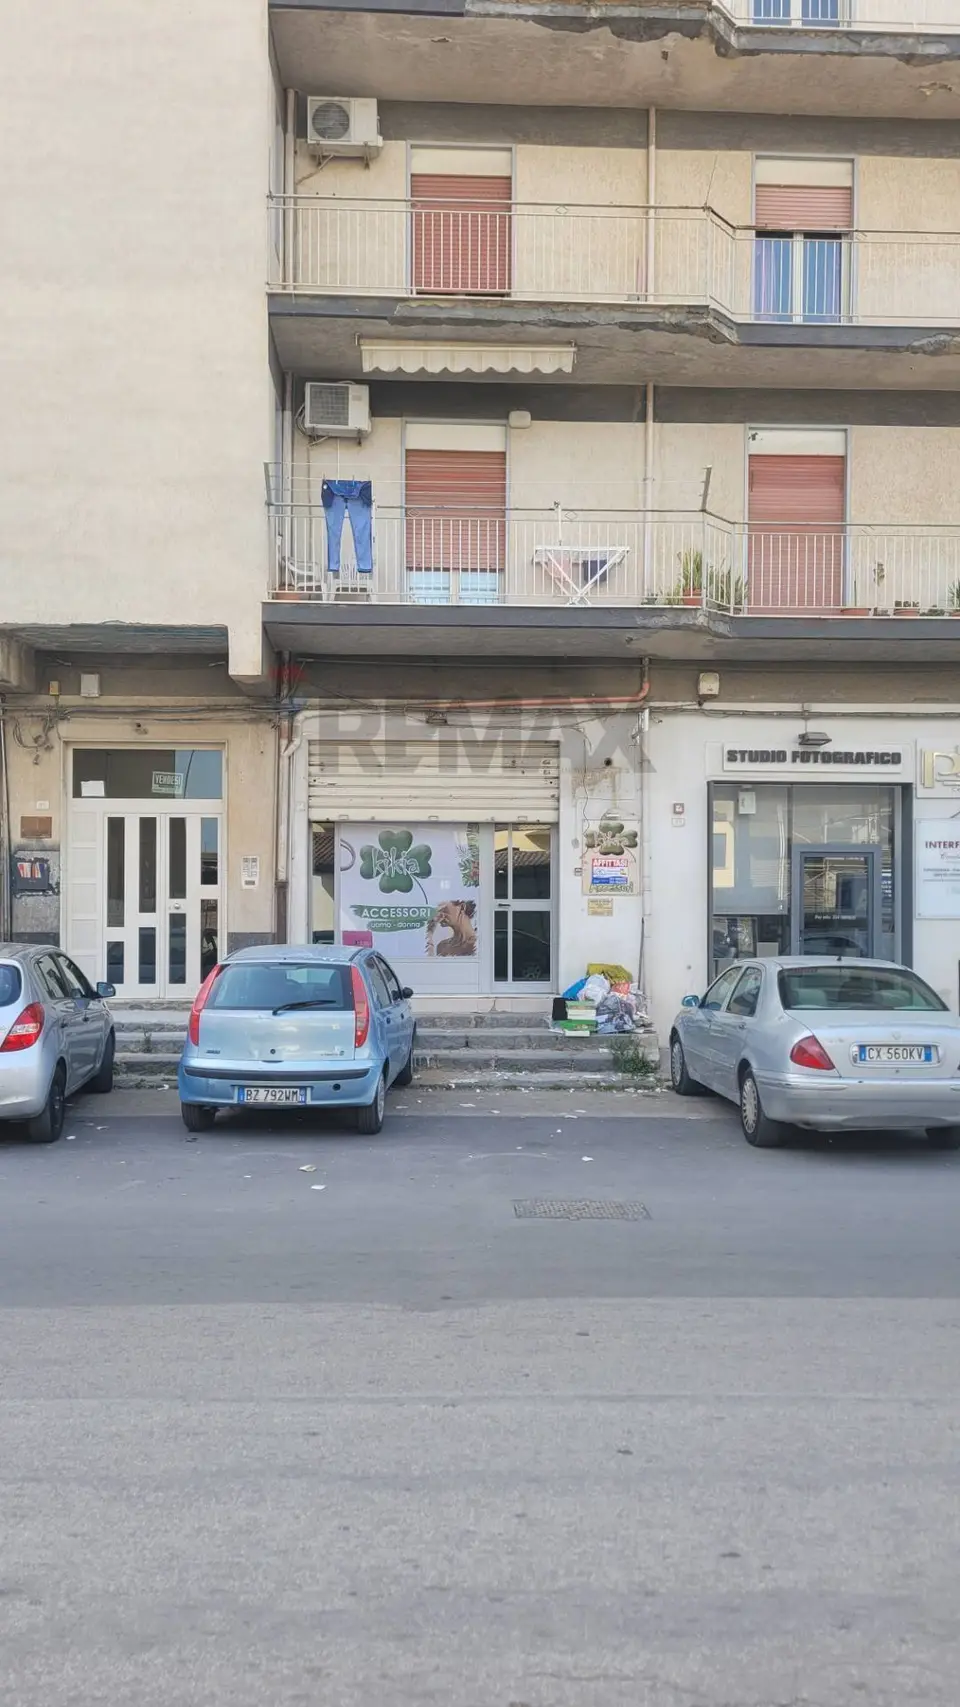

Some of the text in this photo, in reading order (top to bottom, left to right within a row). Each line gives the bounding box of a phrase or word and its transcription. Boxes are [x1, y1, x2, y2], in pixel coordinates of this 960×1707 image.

[726, 750, 902, 765] STUDIO FOTOGRAFICO
[361, 908, 431, 918] ACCESSORI
[868, 1047, 923, 1060] CX 560KV
[246, 1089, 298, 1101] BZ 792WM
